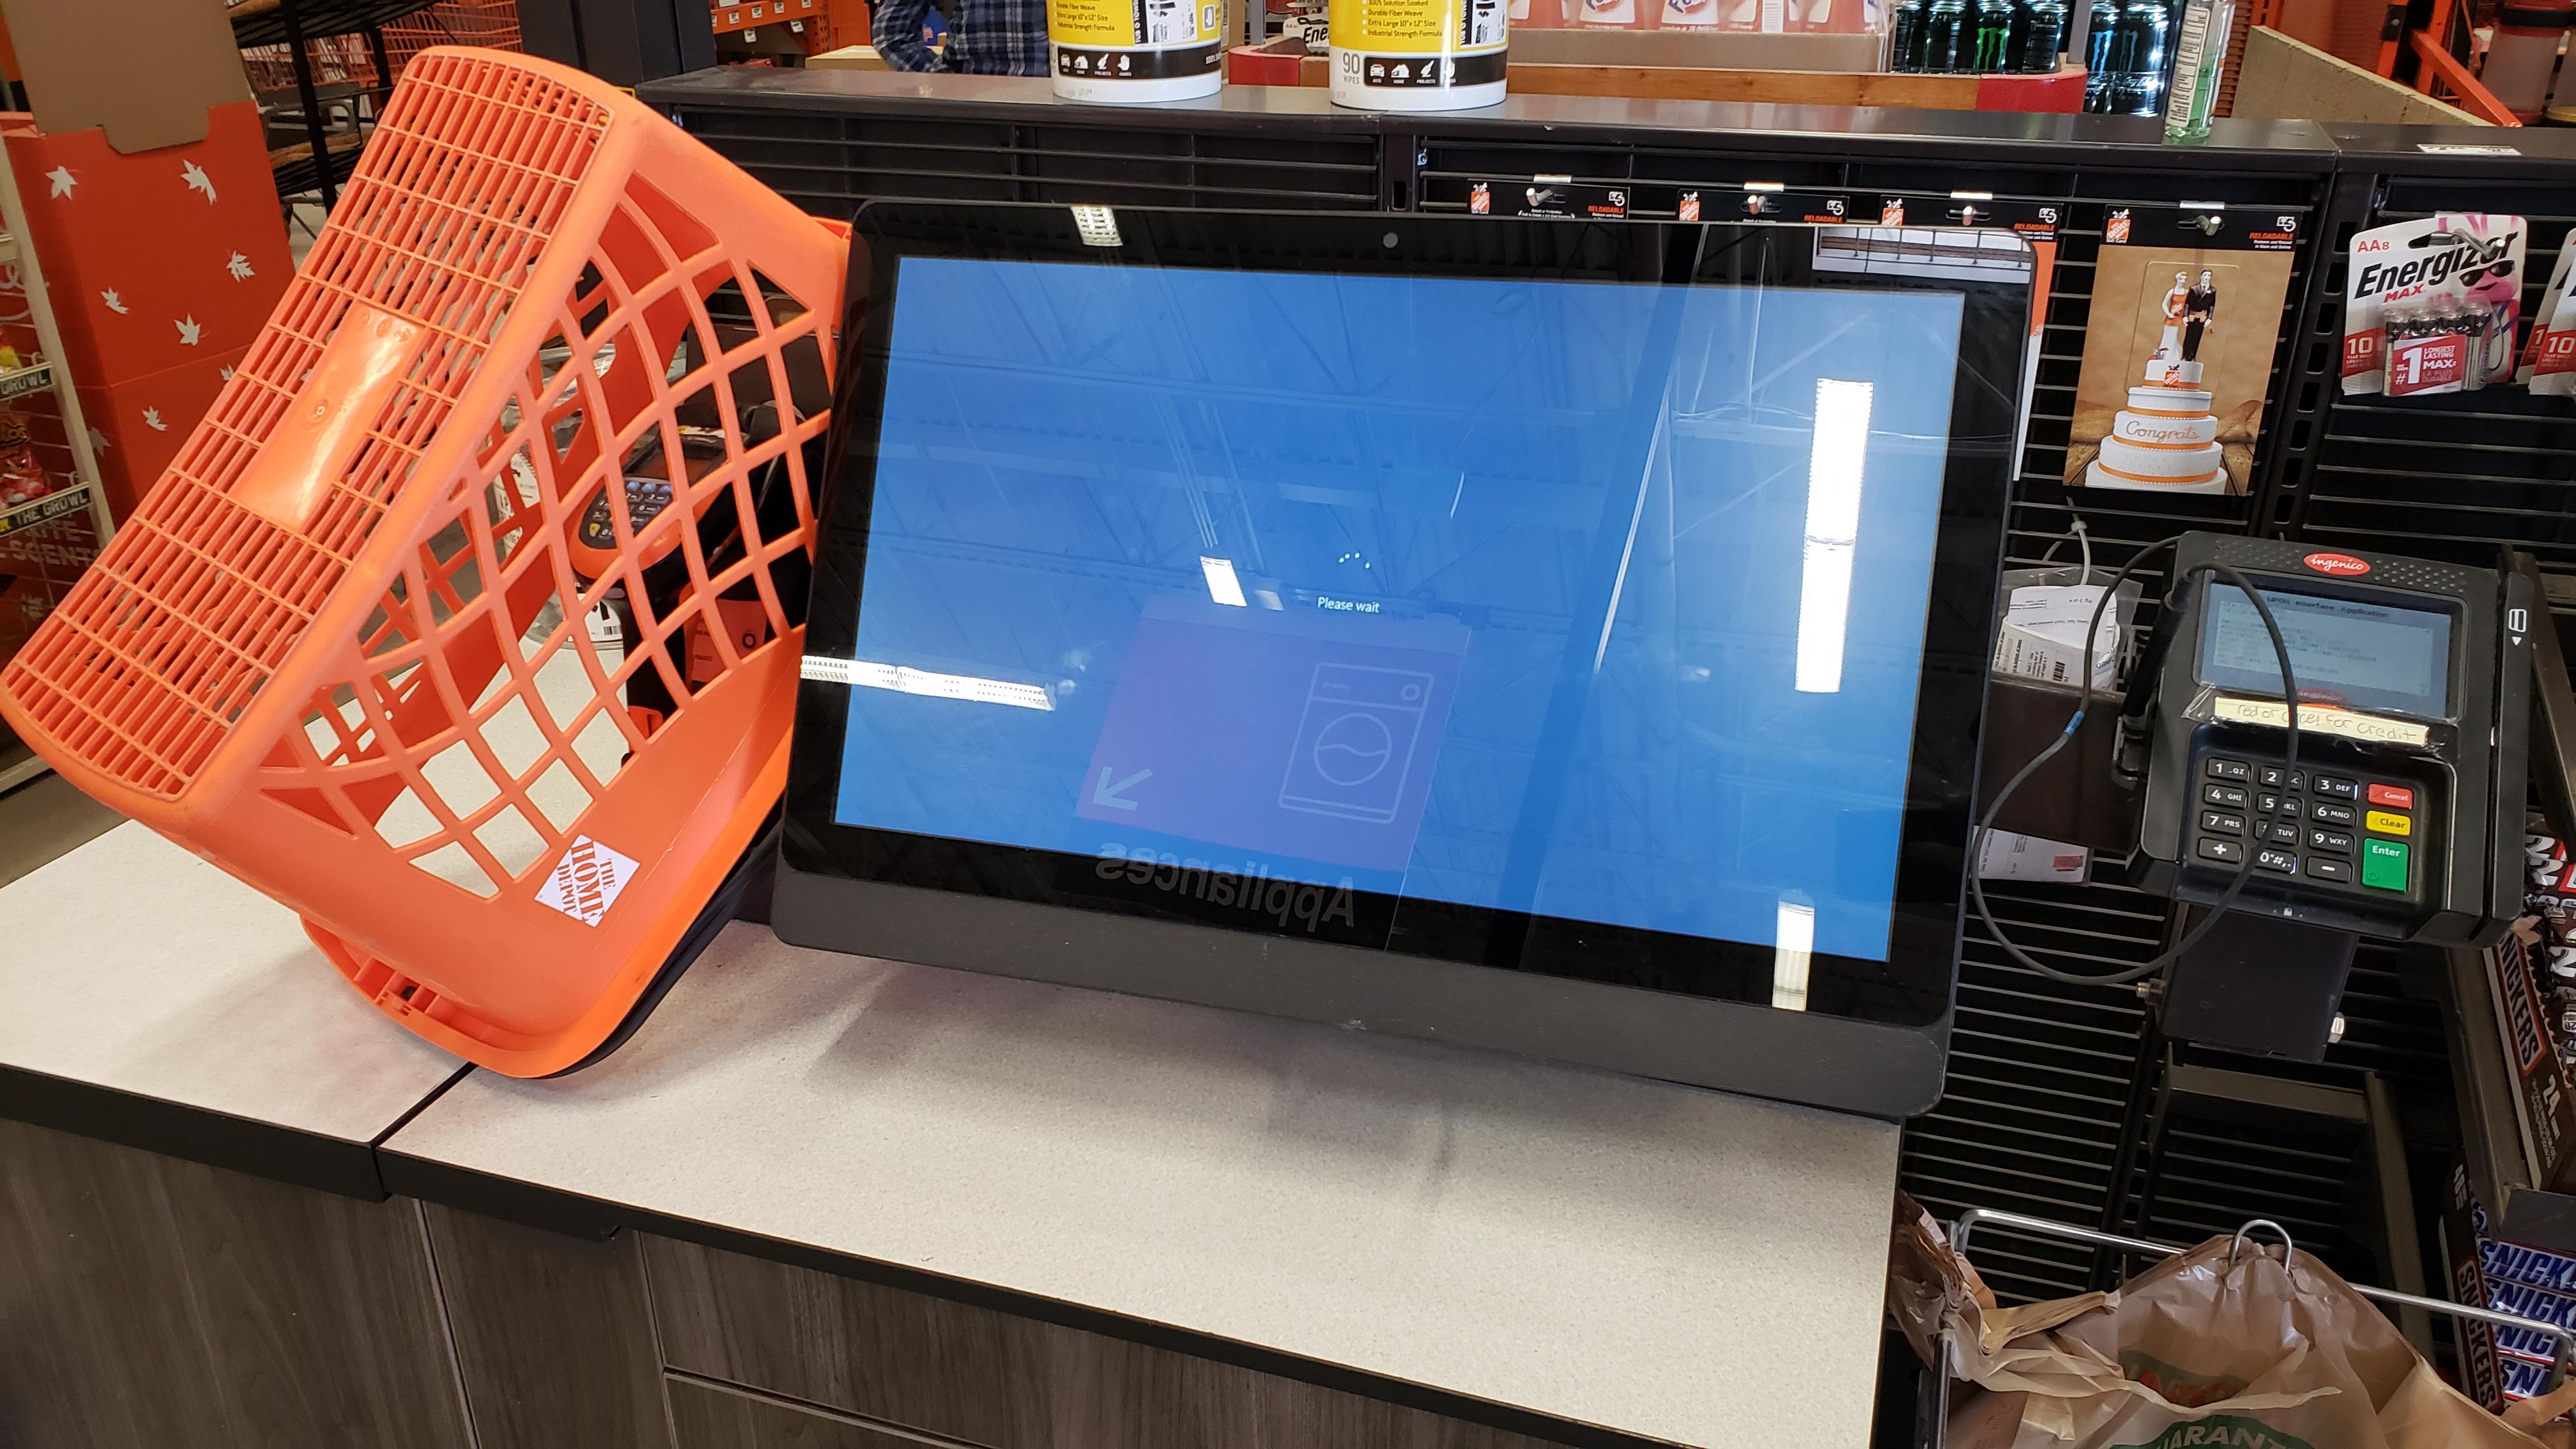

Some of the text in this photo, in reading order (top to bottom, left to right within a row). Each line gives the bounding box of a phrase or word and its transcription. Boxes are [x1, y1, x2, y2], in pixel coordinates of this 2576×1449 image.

[1394, 31, 1418, 39] Strength
[1343, 52, 1360, 75] 90
[1344, 76, 1360, 85] WIPES
[1804, 215, 1843, 223] RELOADABLE
[2384, 283, 2425, 303] MAX
[2348, 337, 2373, 355] 10
[2425, 346, 2456, 354] LONGEST
[2549, 336, 2575, 354] 10
[2423, 351, 2455, 360] LASTING
[2126, 420, 2199, 442] Congrats
[2310, 555, 2363, 571] ingenico
[1317, 596, 1380, 613] Please wait
[2296, 600, 2334, 611] Interface
[2341, 607, 2388, 618] Application
[2216, 763, 2223, 773] 1
[2267, 772, 2277, 782] 2
[2320, 779, 2352, 792] 3 DEF
[2211, 790, 2242, 802] 4 GHI
[2384, 792, 2408, 801] Cancel
[2266, 798, 2274, 808] 5
[2317, 806, 2350, 819] 6 MNO
[2209, 815, 2241, 828] 7 PRS
[2380, 818, 2406, 829] Clear
[2277, 829, 2294, 837] TUV
[2315, 833, 2347, 846] 9 WXY
[2372, 845, 2401, 857] Enter
[571, 839, 605, 921] HOME
[600, 857, 617, 890] THE
[557, 863, 578, 912] DEPOT
[2499, 931, 2542, 1066] NICKERS
[2480, 1240, 2576, 1292] SNICK
[2485, 1277, 2576, 1330] SNICK
[2460, 1267, 2496, 1407] SNCKERS
